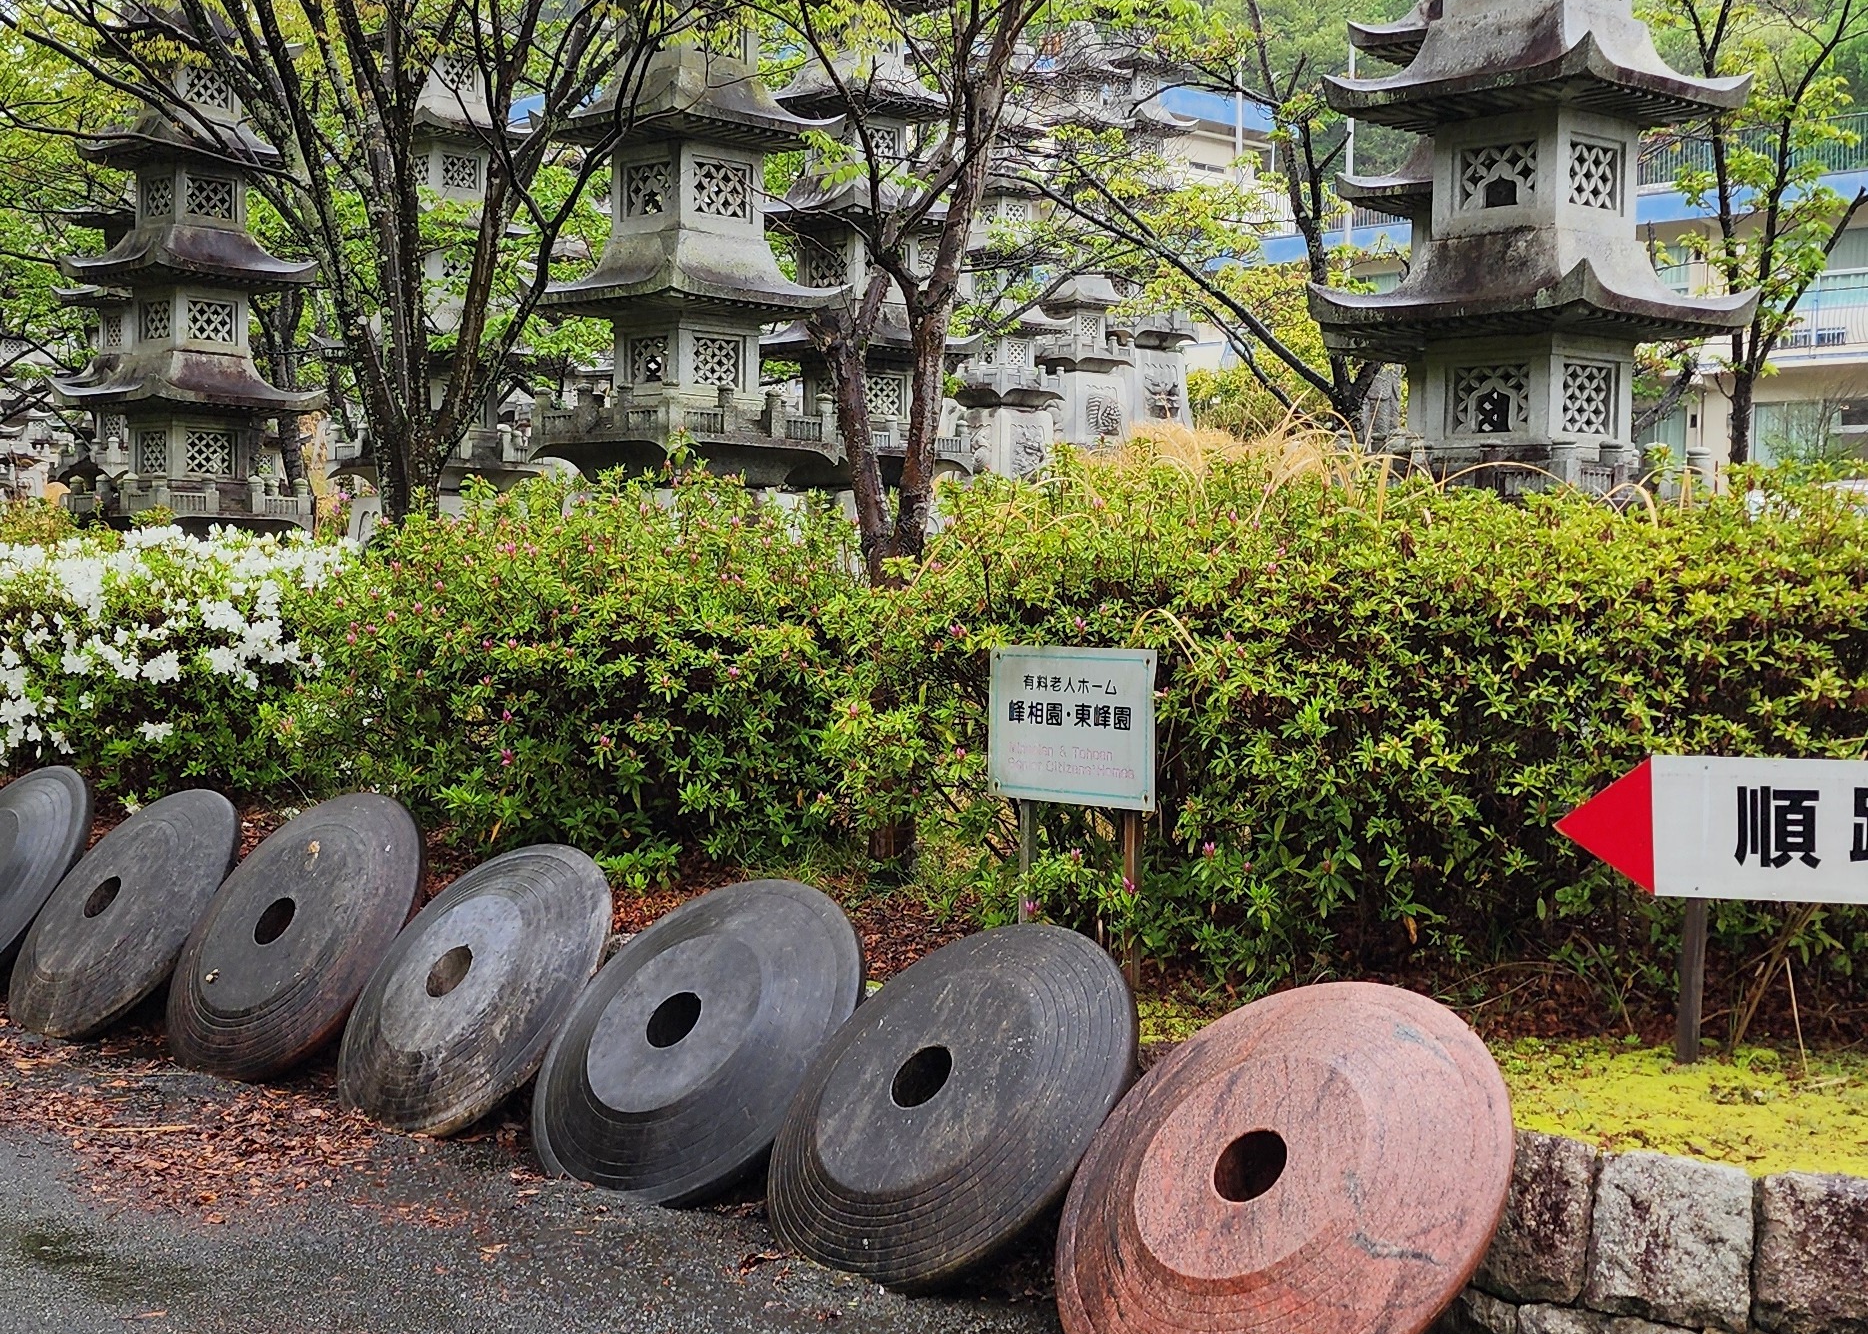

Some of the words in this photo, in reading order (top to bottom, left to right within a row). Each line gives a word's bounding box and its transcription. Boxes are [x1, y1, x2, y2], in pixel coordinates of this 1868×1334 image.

[1023, 674, 1117, 695] 有料老人ホーム
[1008, 700, 1132, 731] 峰相園・東峰園
[1059, 745, 1067, 758] &
[1734, 786, 1868, 869] 順
